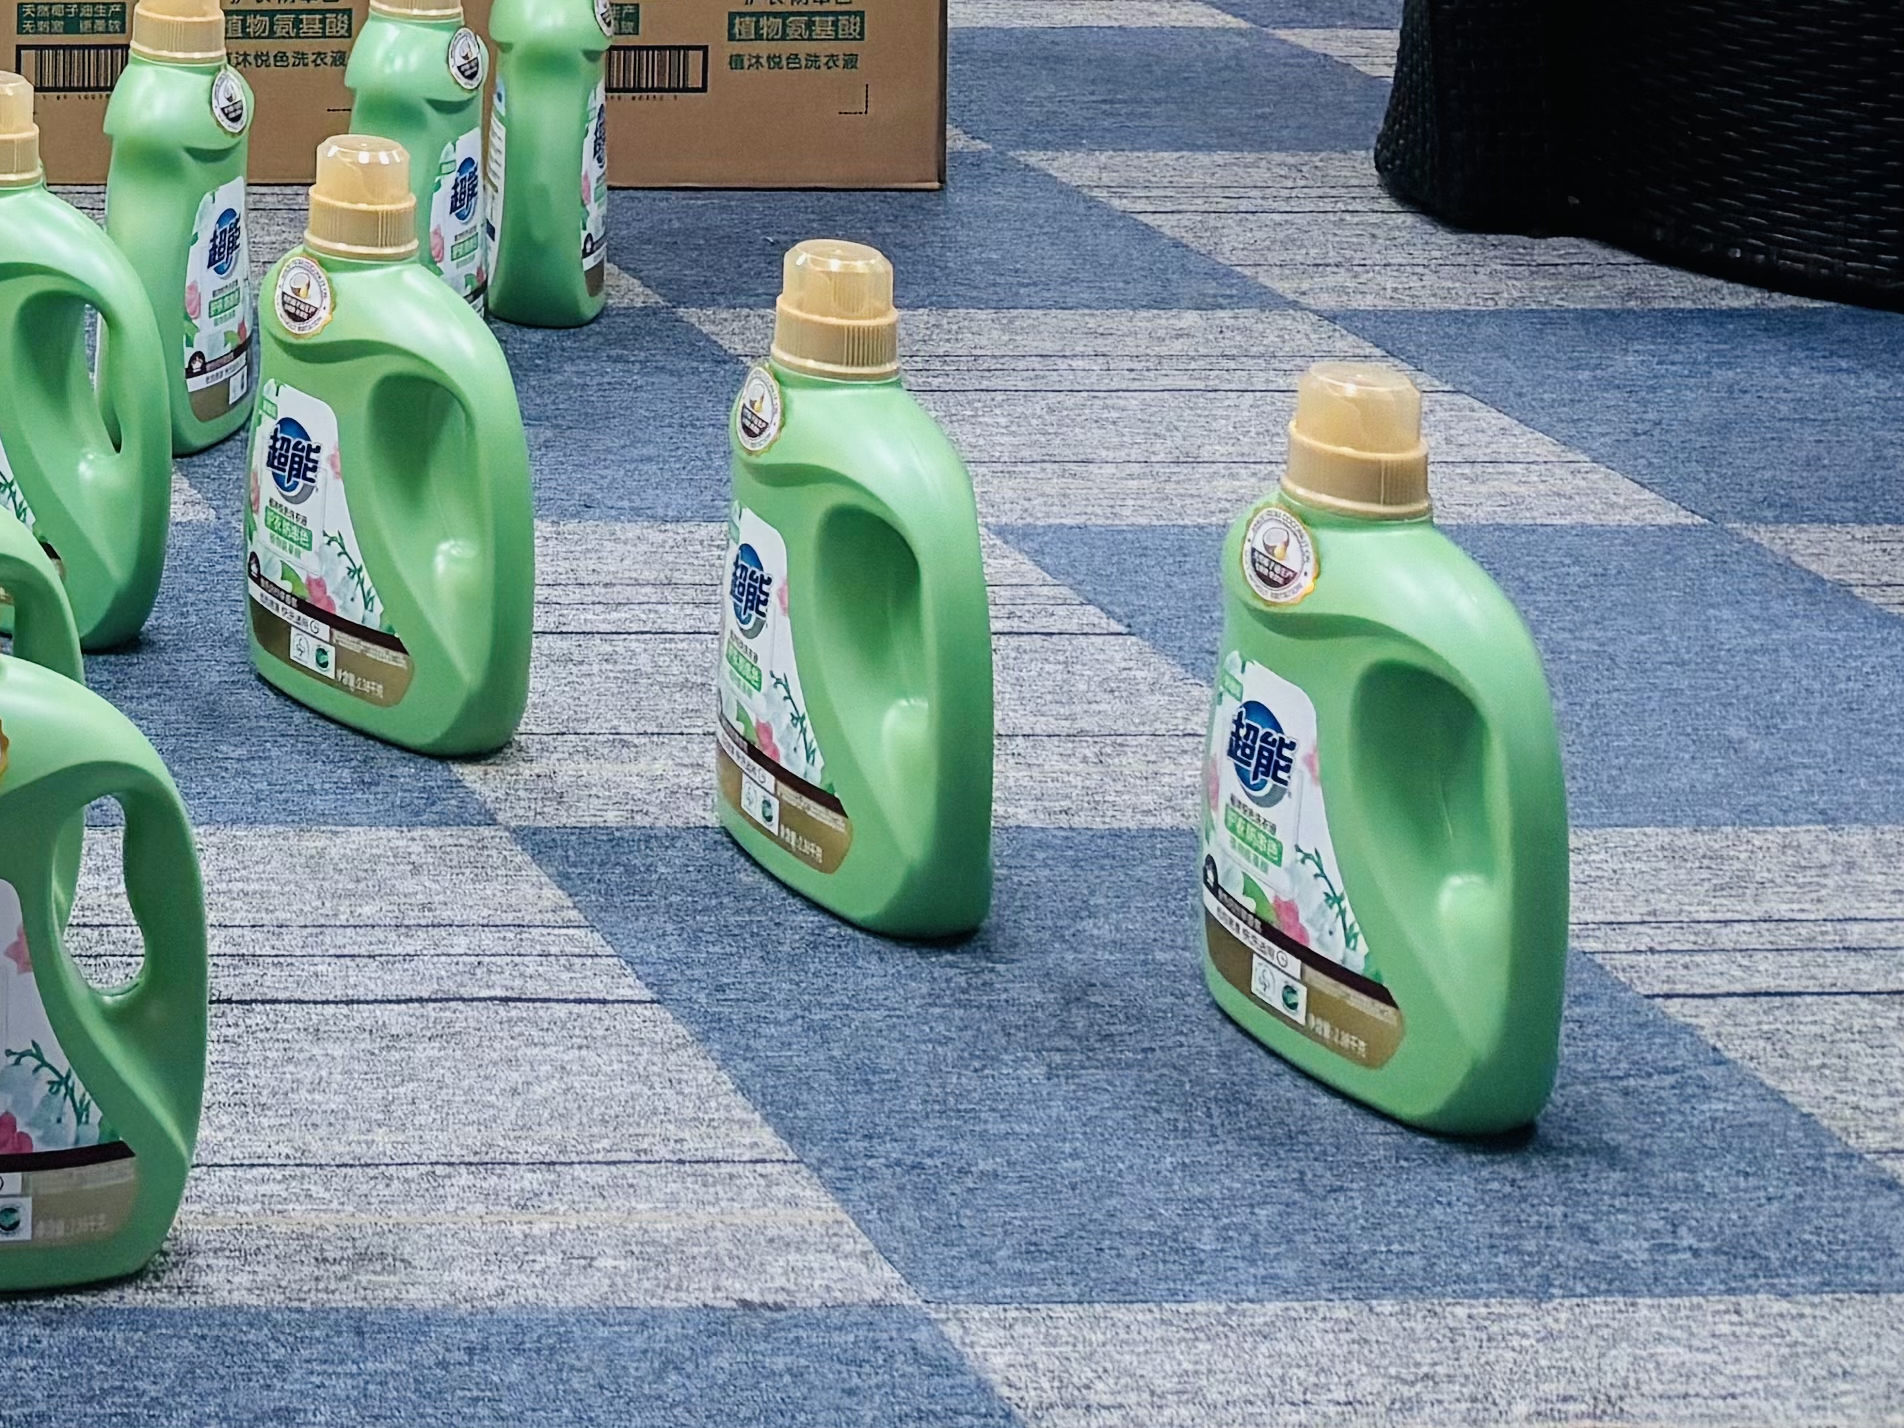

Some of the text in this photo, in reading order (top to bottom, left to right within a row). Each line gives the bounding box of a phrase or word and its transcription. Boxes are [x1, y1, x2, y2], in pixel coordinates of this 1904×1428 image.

[734, 16, 862, 39] 植物氨基酸
[729, 54, 859, 71] 植沐悦色洗衣液
